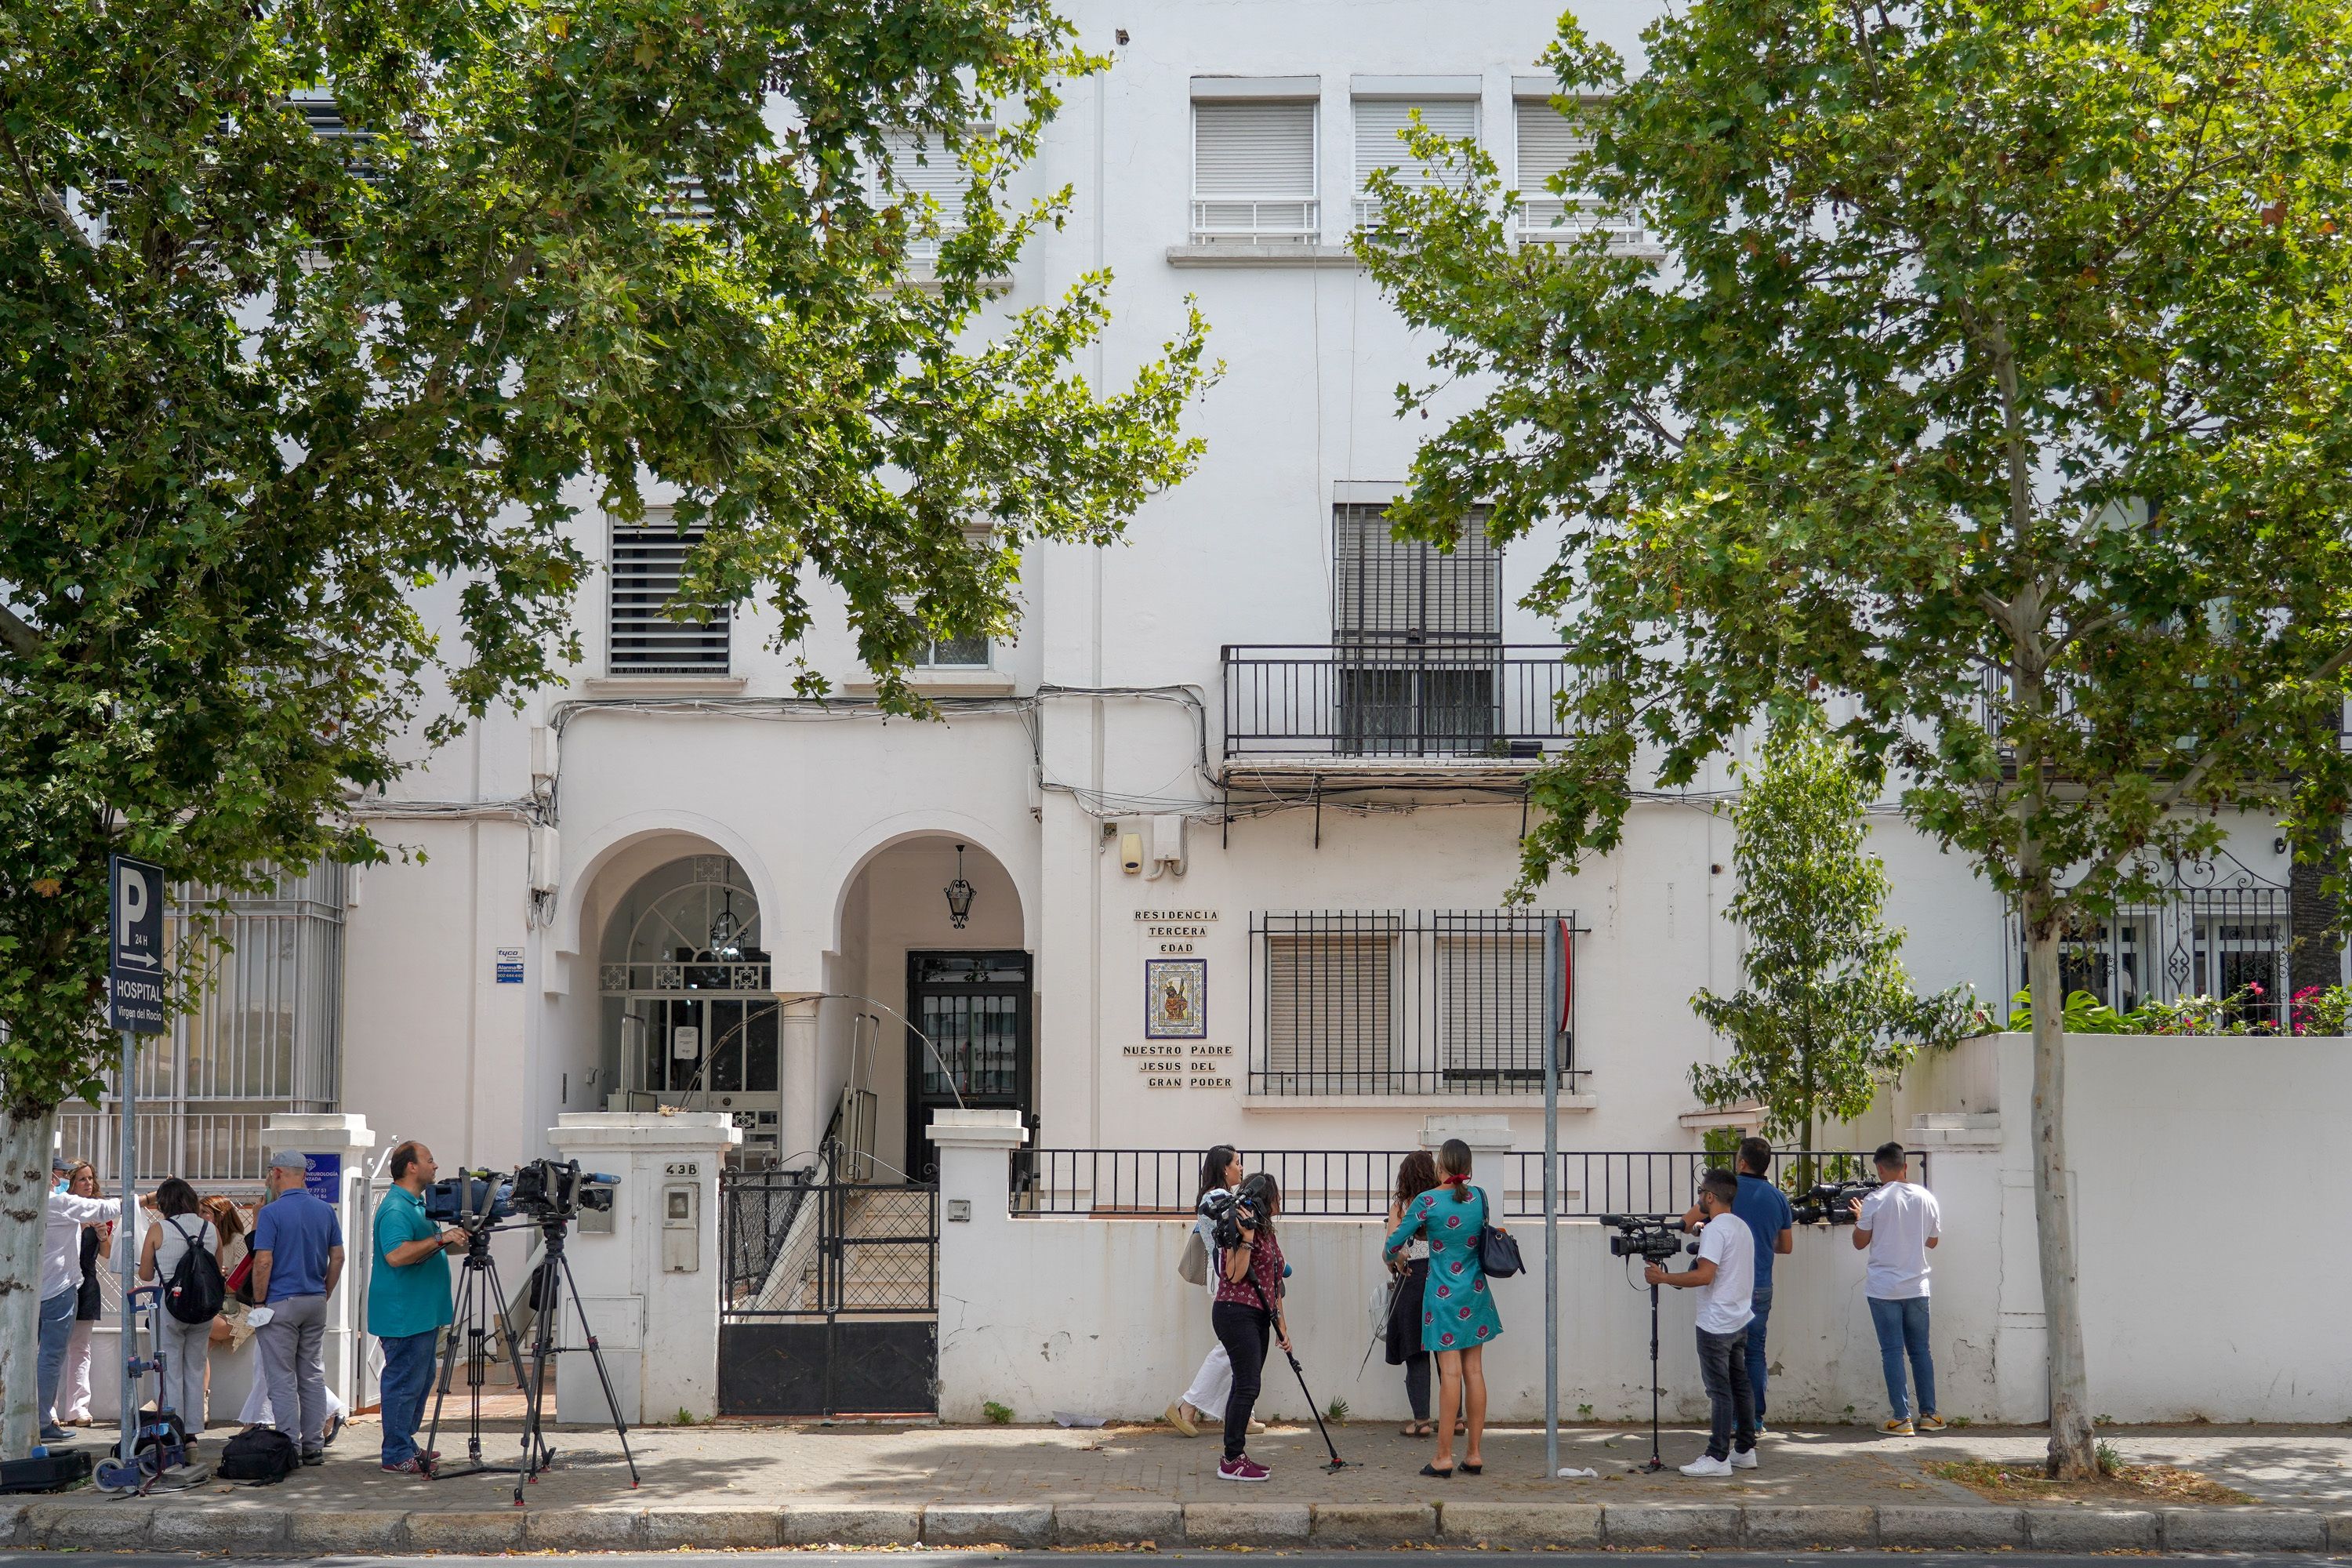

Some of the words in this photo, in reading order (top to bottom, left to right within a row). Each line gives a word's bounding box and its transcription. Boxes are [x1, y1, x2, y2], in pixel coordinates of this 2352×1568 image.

[120, 866, 148, 946] P
[135, 934, 142, 945] 24
[143, 935, 148, 946] H
[117, 979, 162, 1002] HOSPITAL
[118, 1005, 136, 1019] Virgen
[136, 1008, 146, 1018] del
[146, 1009, 162, 1022] Rocío
[1149, 1078, 1181, 1087] GRAN
[1191, 1078, 1231, 1087] PODER
[666, 1164, 696, 1174] 43B
